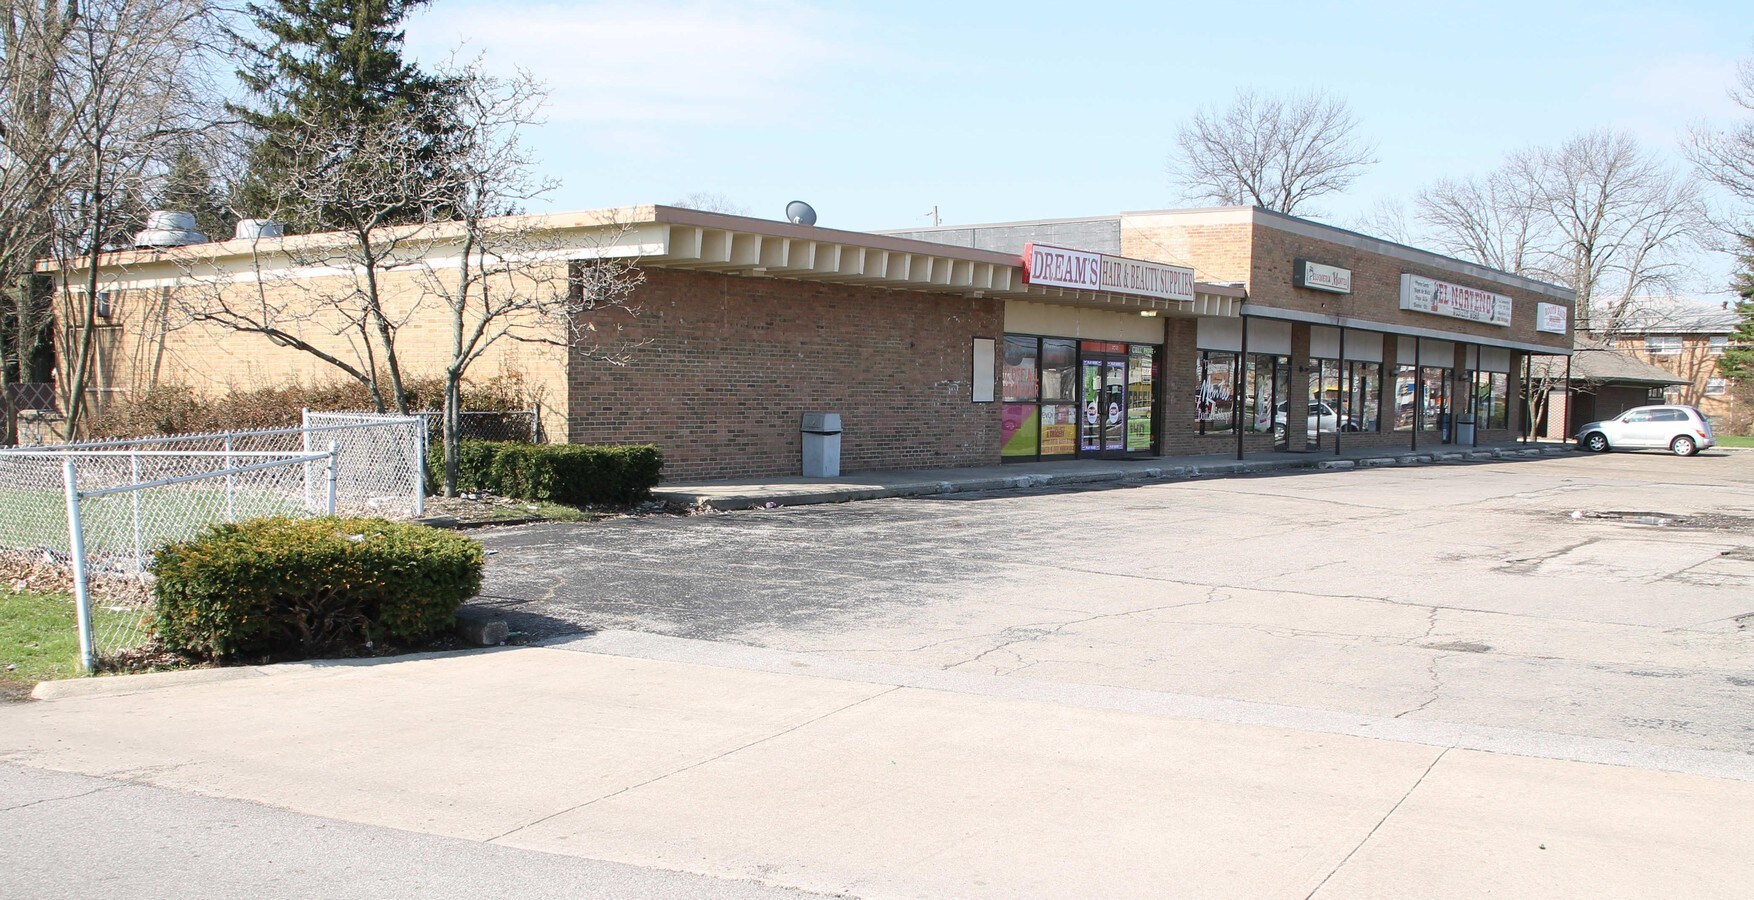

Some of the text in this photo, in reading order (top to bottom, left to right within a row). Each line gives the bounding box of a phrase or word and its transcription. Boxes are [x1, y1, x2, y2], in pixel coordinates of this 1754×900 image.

[1032, 250, 1099, 286] DREAM'S
[1102, 260, 1193, 297] HAIR & BEAUTY SUPPLIES
[1438, 283, 1449, 304] EL
